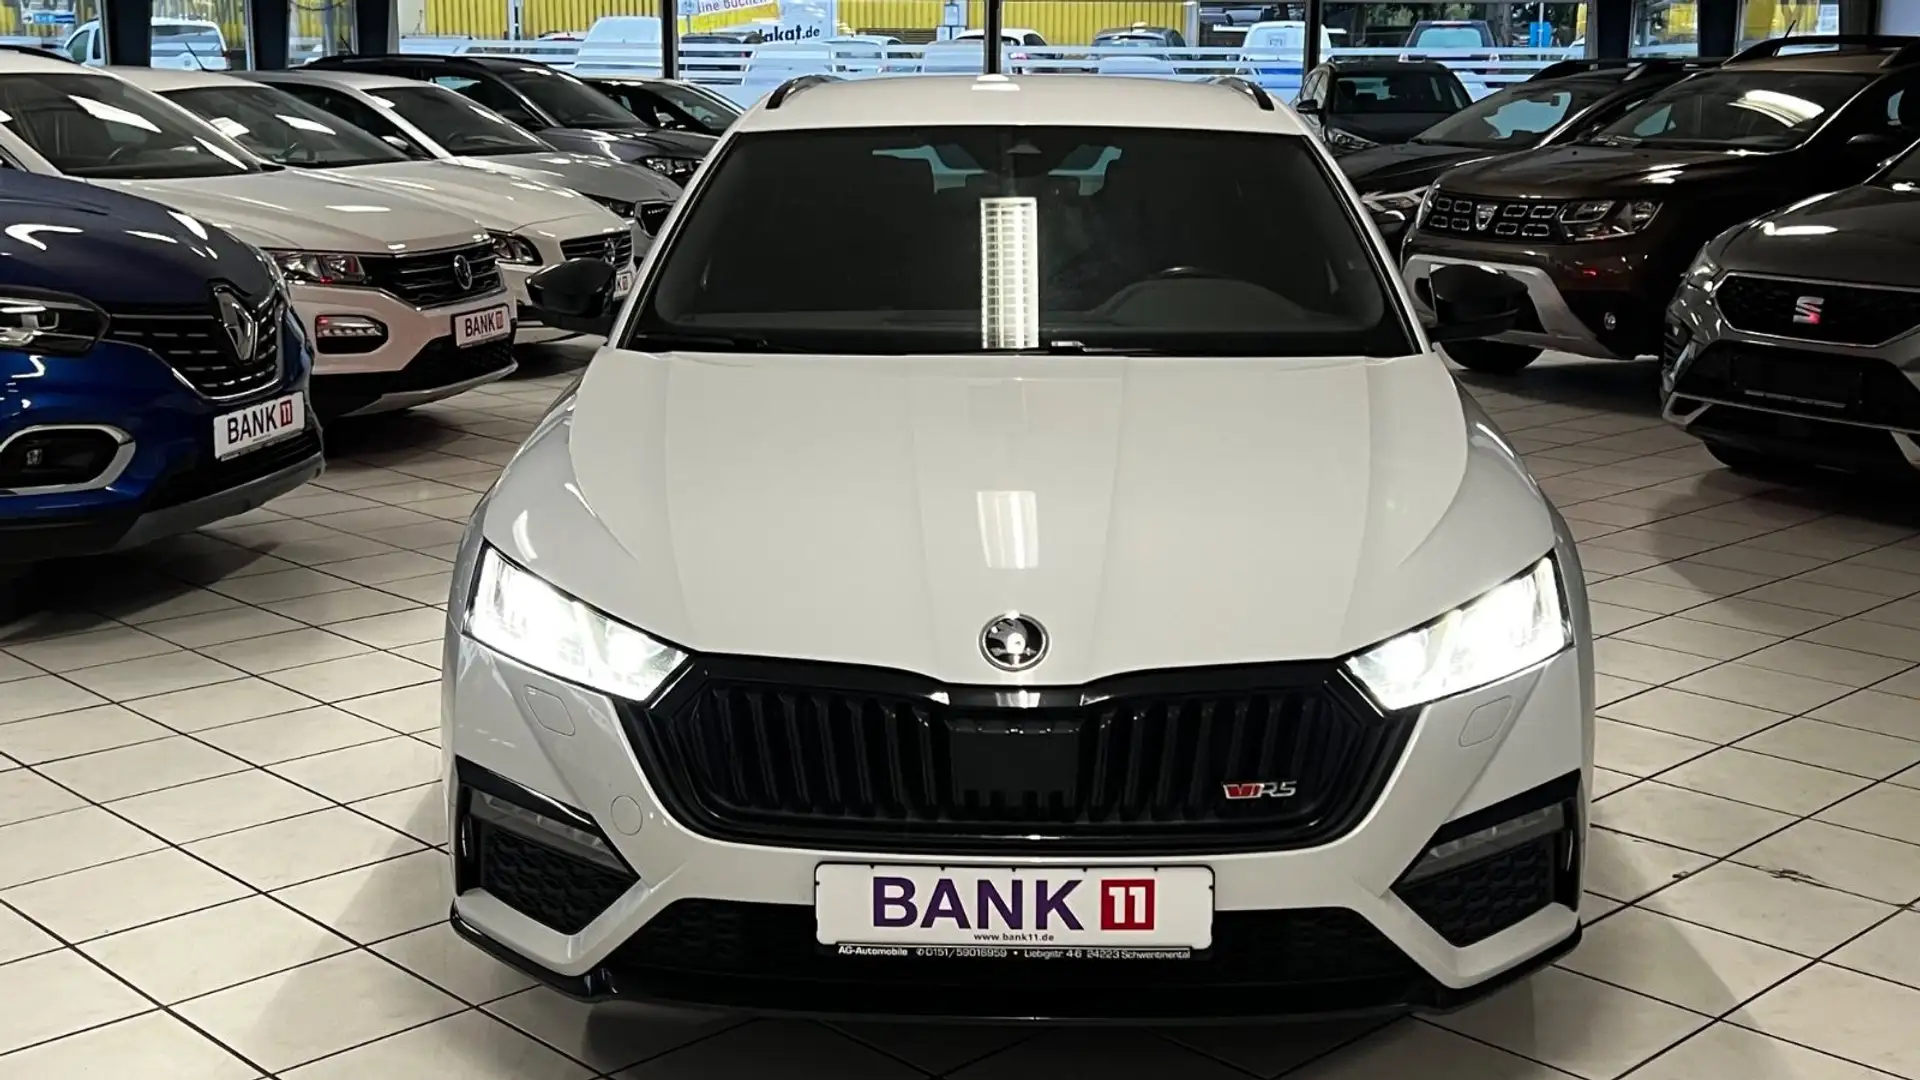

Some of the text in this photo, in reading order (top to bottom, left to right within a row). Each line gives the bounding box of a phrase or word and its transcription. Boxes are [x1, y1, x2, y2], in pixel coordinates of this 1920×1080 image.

[464, 312, 496, 337] BANK
[227, 401, 292, 445] BANK 11
[873, 876, 1149, 930] BANK 11
[973, 933, 1055, 941] www.bank11.de
[838, 946, 908, 956] AG-Automobile
